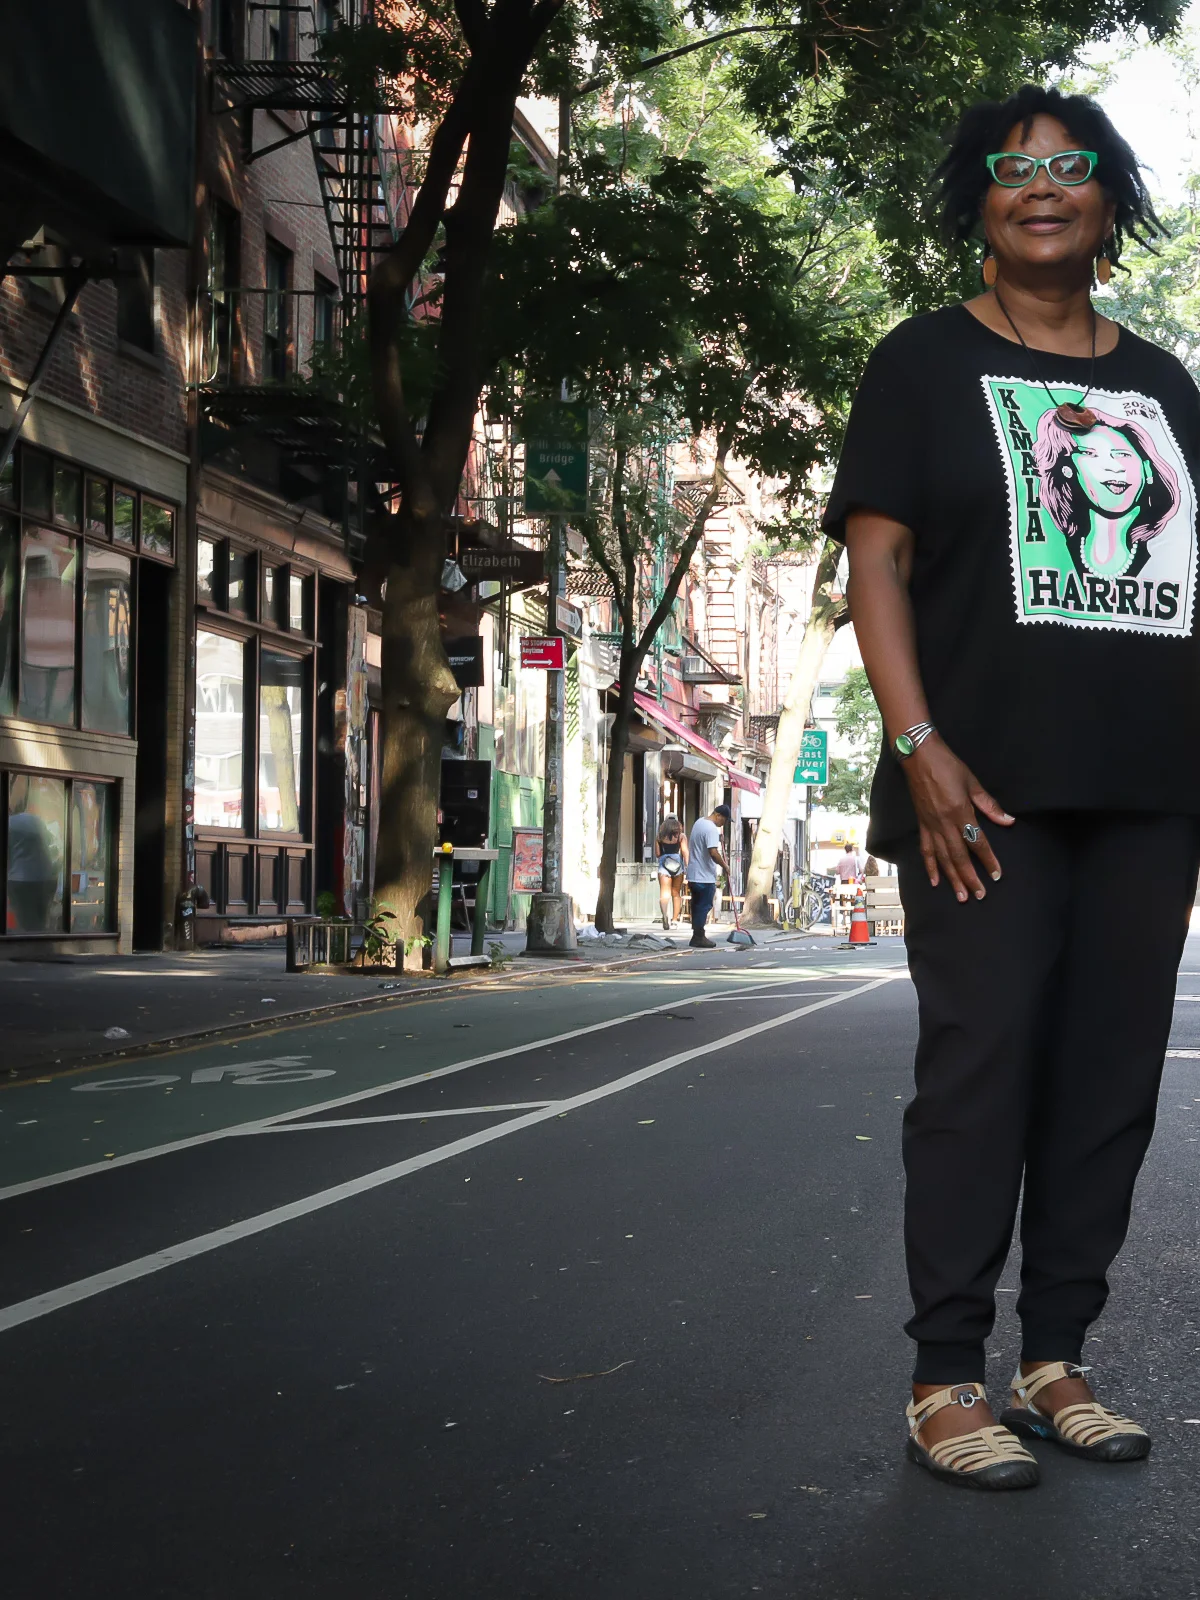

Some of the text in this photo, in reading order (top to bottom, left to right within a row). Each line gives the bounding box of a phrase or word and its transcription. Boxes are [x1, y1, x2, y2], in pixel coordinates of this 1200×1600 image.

[539, 453, 574, 466] Bridge
[998, 388, 1046, 542] KAMALA
[462, 554, 521, 568] Elizabeth
[1028, 569, 1180, 620] HARRIS
[522, 647, 544, 655] Anytime
[799, 750, 822, 759] East
